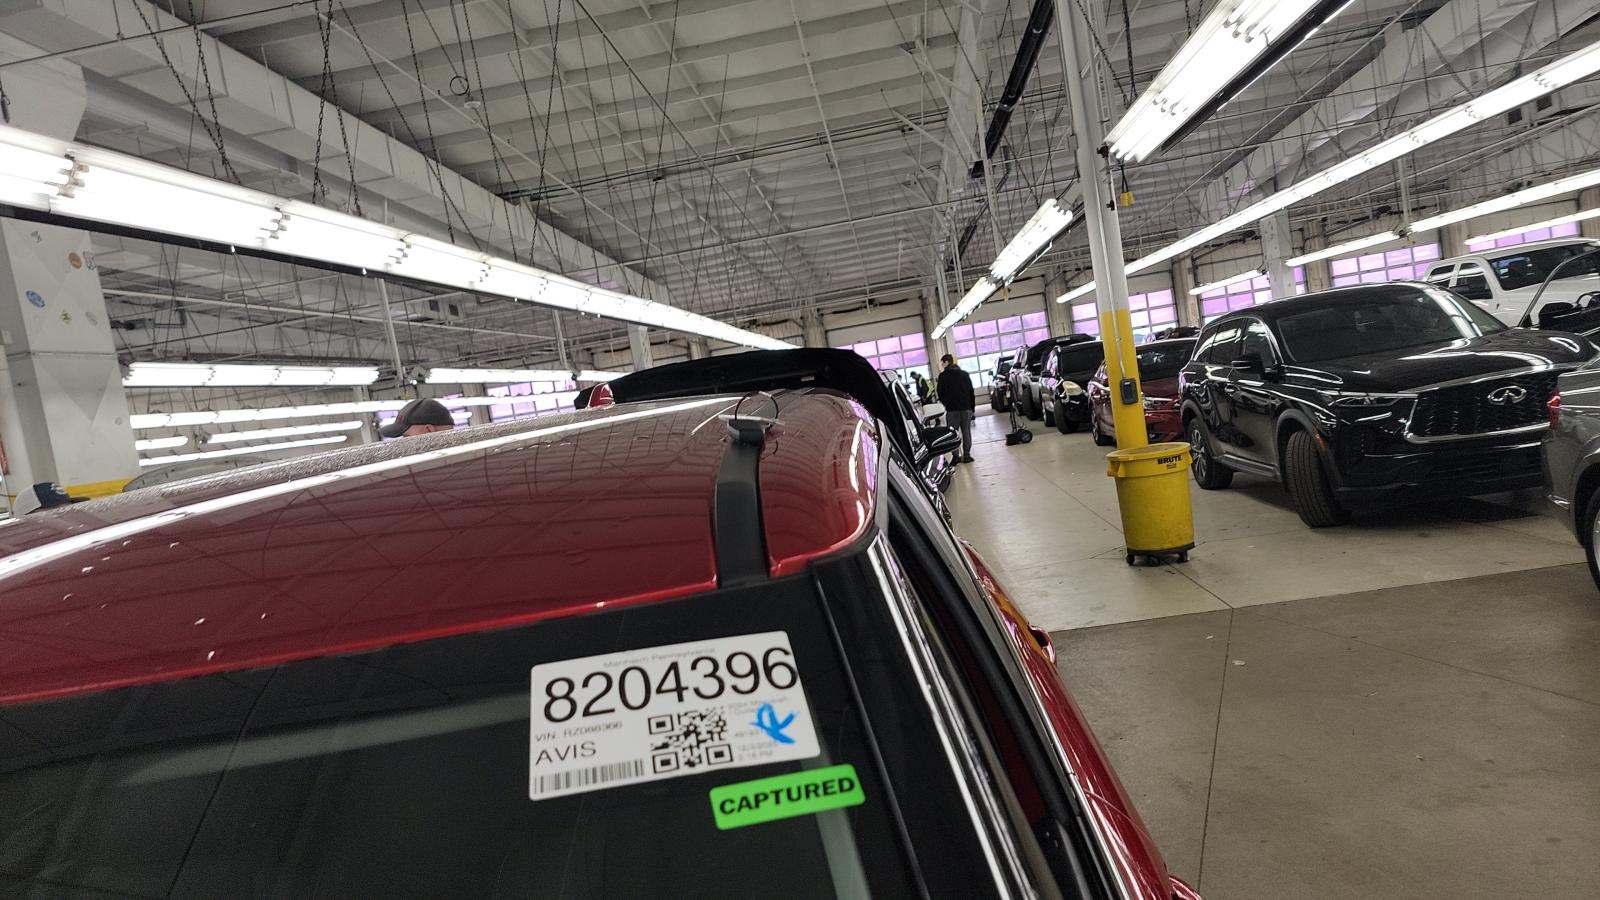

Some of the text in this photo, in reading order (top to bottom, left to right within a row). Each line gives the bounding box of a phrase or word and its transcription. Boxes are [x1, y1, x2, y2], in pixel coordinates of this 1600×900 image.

[1157, 454, 1183, 465] BRUTE
[543, 647, 798, 723] 8204396
[535, 741, 597, 766] AVIS
[719, 776, 856, 815] CAPTURED
